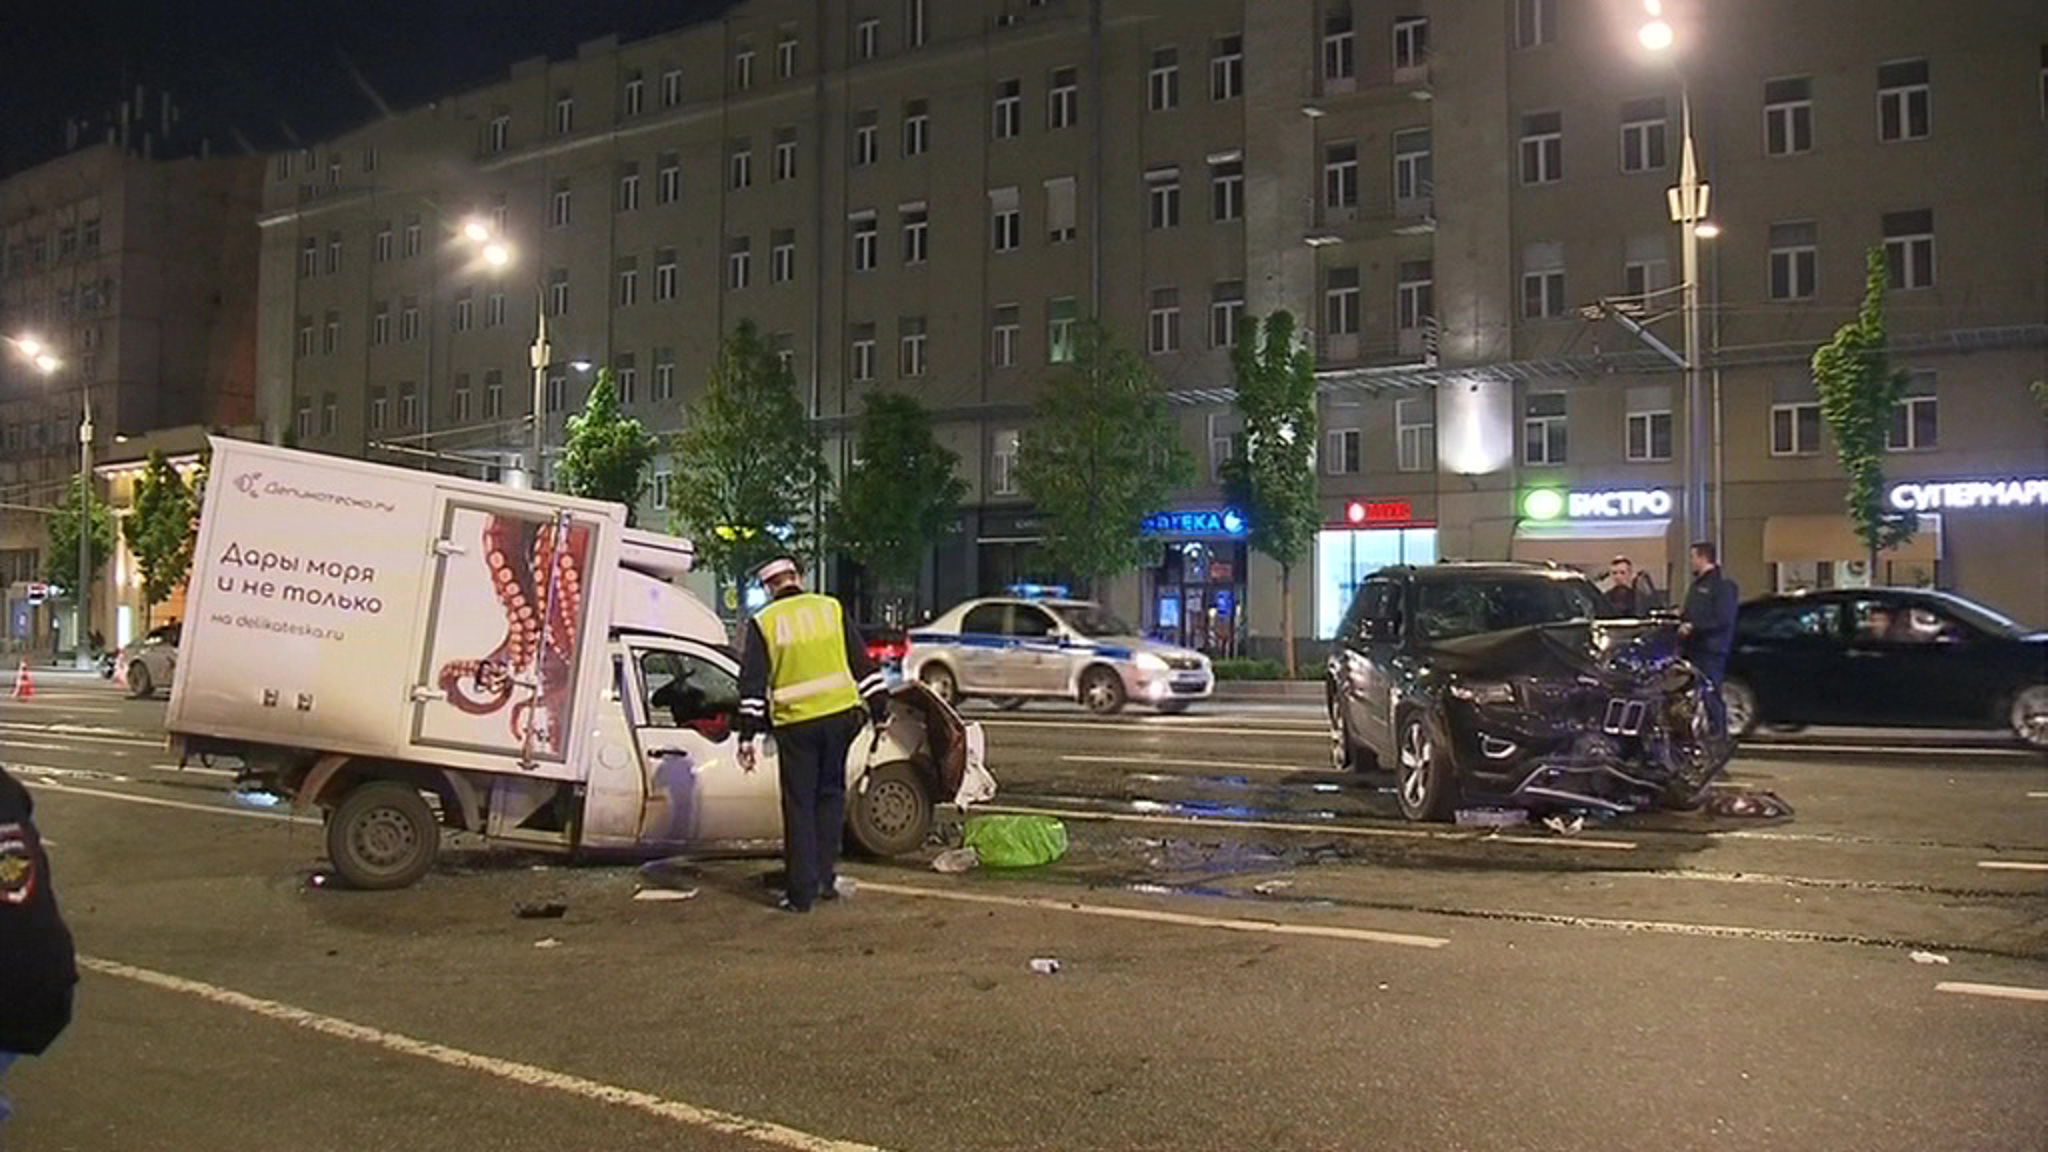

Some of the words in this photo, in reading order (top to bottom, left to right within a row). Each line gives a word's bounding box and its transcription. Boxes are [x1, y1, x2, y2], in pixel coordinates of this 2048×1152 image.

[1568, 489, 1671, 517] БИСТРО
[220, 541, 299, 573] Дары
[306, 559, 375, 584] моря
[217, 576, 234, 592] и
[241, 579, 276, 599] не
[282, 585, 383, 614] только
[210, 613, 232, 626] на
[235, 615, 345, 641] delikateska.ru
